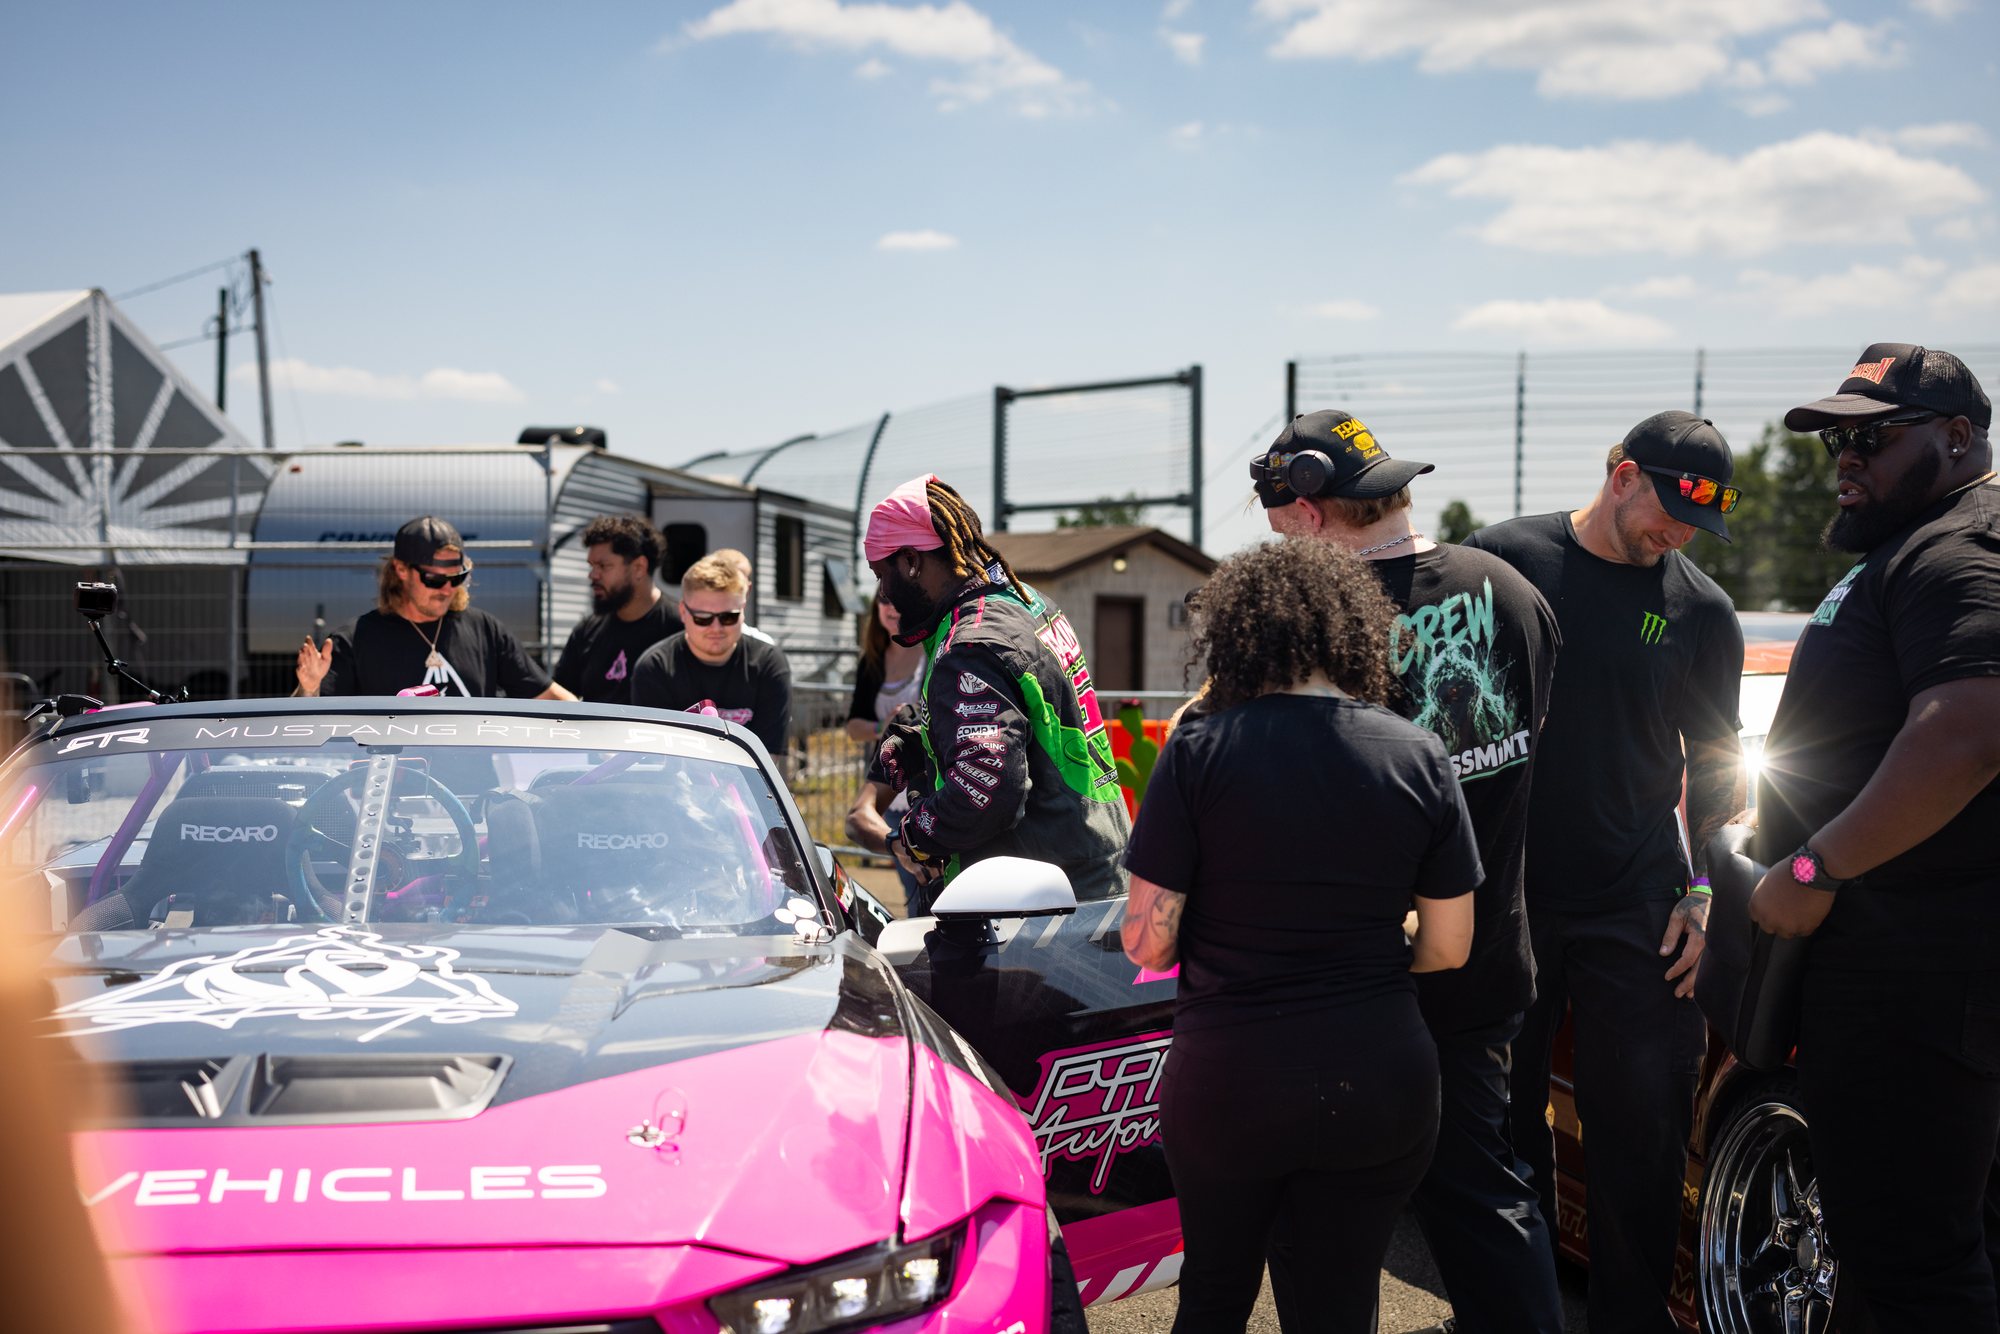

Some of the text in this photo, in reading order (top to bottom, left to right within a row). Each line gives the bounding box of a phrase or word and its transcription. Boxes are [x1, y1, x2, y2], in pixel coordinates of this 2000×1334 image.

[1389, 576, 1494, 674] CREW
[195, 723, 582, 740] MUSTANG RTR
[958, 761, 998, 787] WISEFAB
[180, 823, 278, 843] RECARO
[577, 831, 669, 850] RECARO
